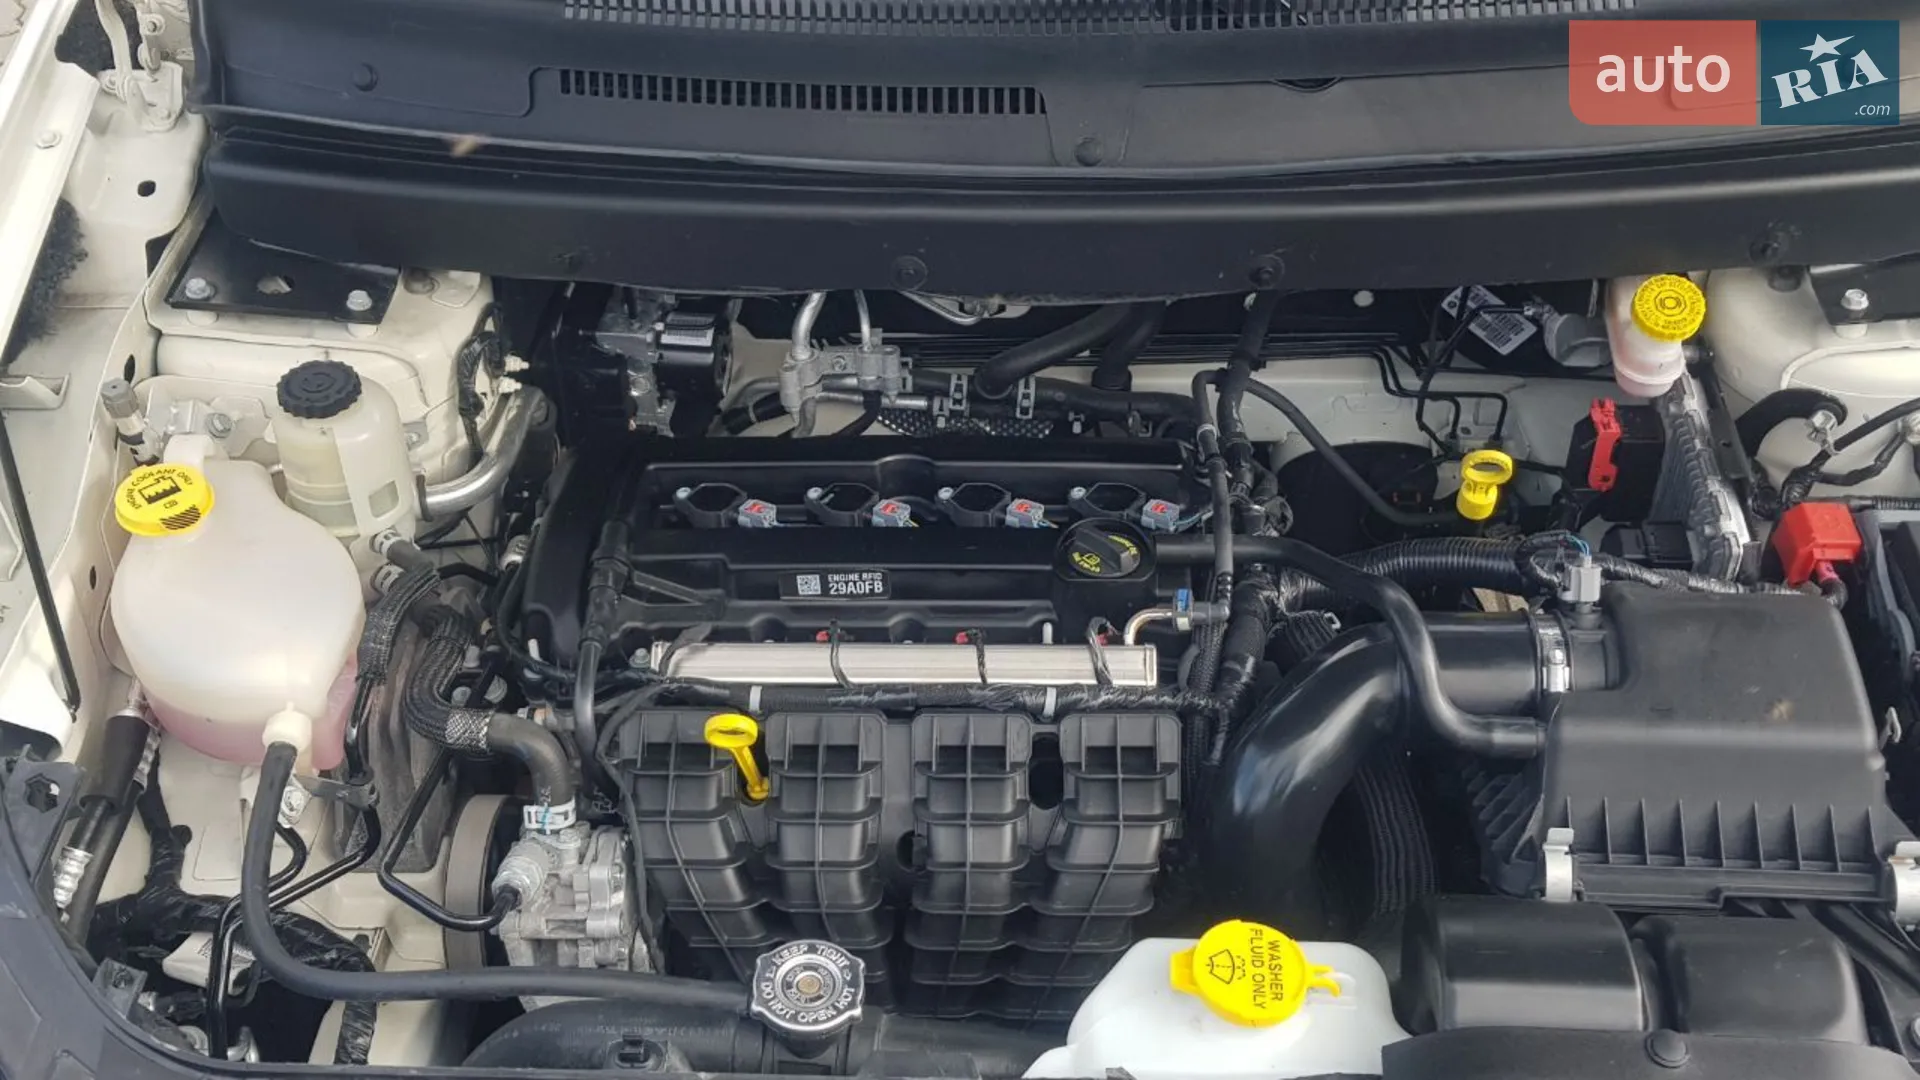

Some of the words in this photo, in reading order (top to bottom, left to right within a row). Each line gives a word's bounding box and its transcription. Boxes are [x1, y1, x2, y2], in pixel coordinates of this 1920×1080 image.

[771, 944, 809, 966] KEEP
[815, 944, 851, 968] TIGHT
[1249, 927, 1265, 969] FLUID
[1267, 939, 1284, 1002] WASHER
[760, 982, 775, 1000] DO
[797, 1006, 838, 1023] OPEN
[1251, 973, 1267, 1010] ONLY
